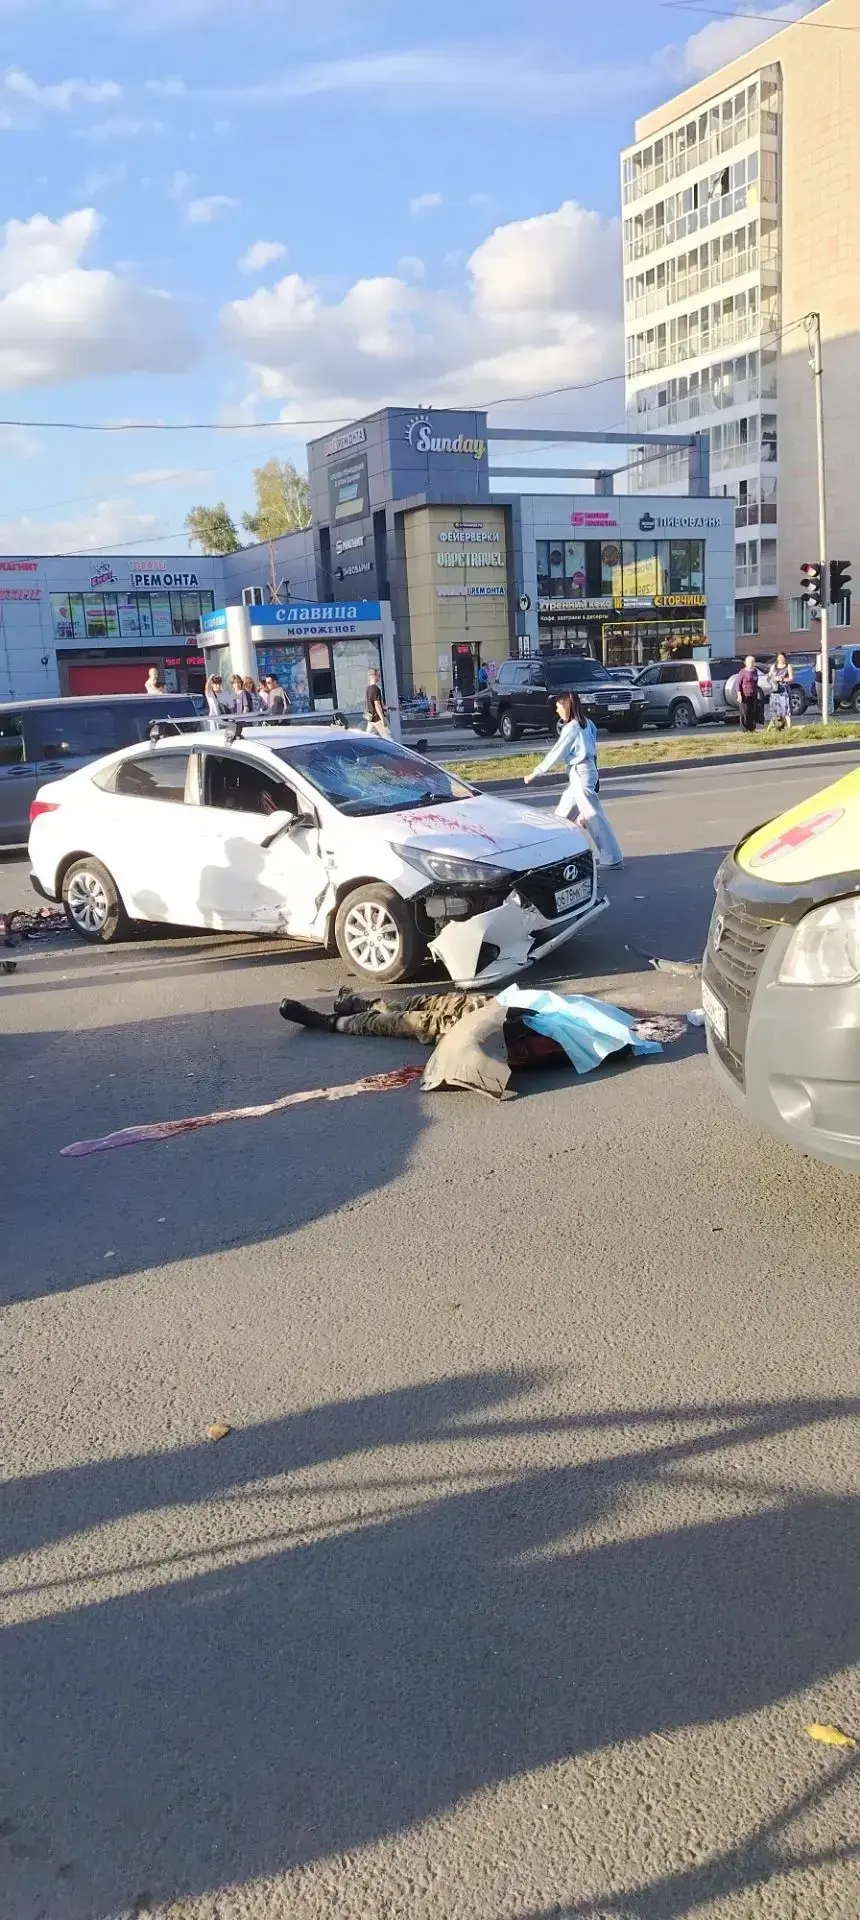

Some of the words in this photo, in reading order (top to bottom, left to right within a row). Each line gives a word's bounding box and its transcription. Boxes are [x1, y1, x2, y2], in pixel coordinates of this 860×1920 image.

[417, 426, 485, 459] Sunday
[660, 516, 722, 527] ПИВОВАРНЯ
[439, 529, 499, 541] ФЕЙЕРВЕРКИ
[437, 552, 505, 567] VAPETRAVEL
[135, 573, 198, 586] РЕМОНТА
[471, 586, 505, 594] РЕМОНТА
[664, 595, 705, 606] ГОРЧИЦА
[287, 625, 356, 636] МОРОЖЕНОЕ
